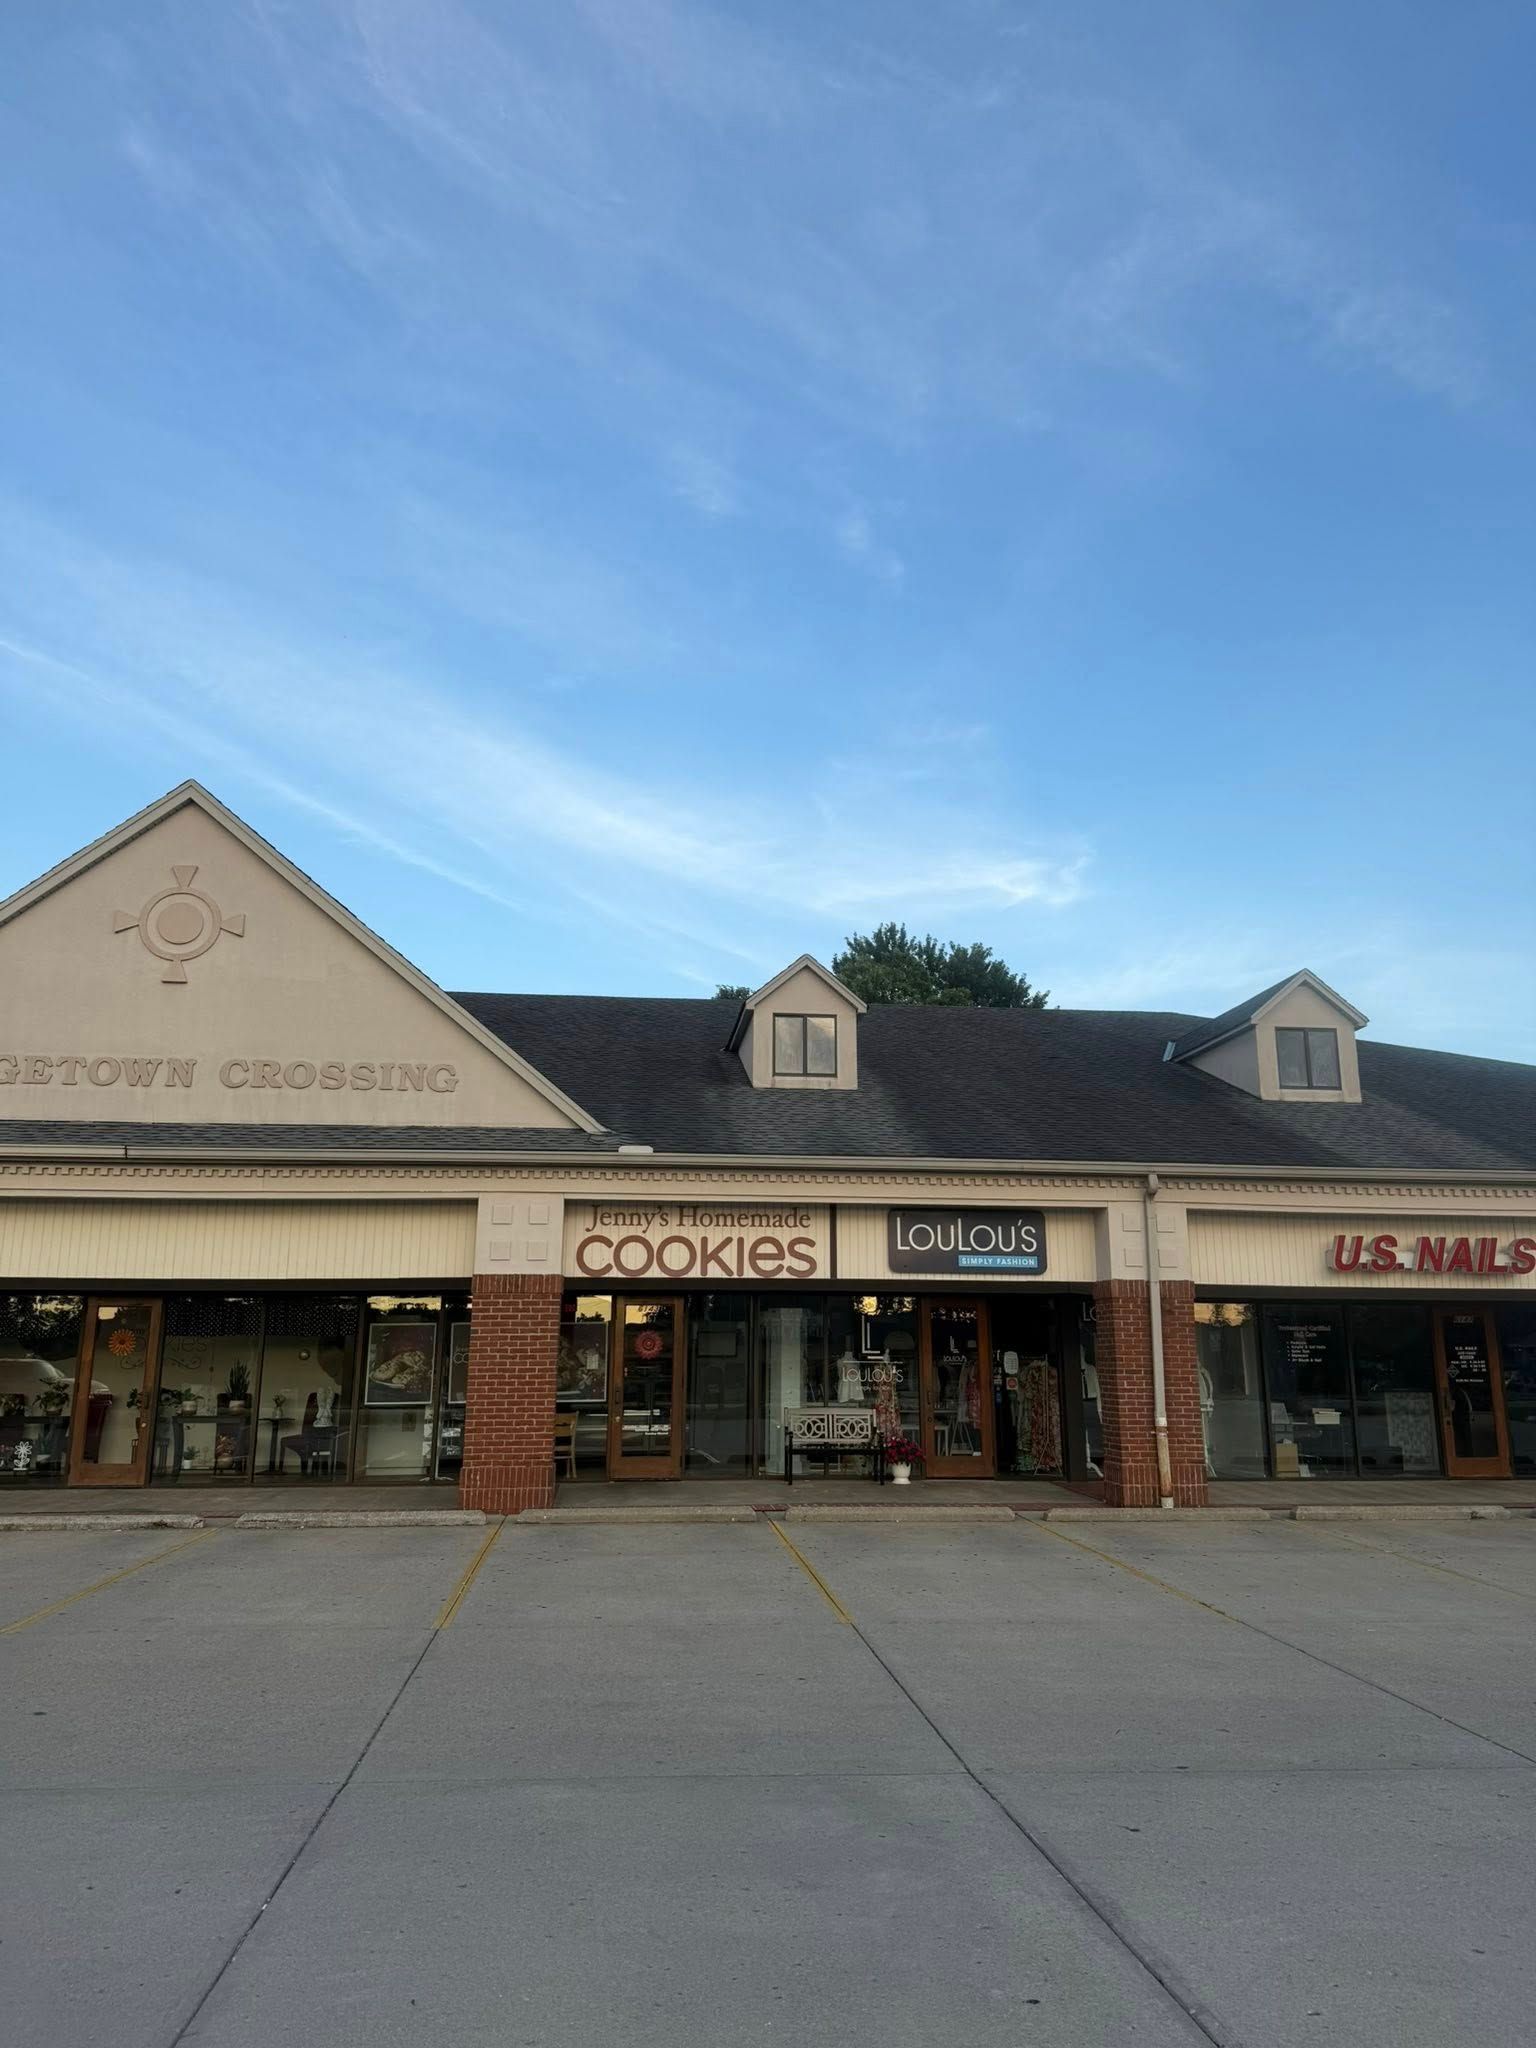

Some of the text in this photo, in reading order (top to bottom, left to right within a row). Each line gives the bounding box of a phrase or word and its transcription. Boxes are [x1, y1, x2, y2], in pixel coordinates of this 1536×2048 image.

[219, 1058, 459, 1093] CROSSING
[586, 1204, 811, 1233] Jenny's Homemade
[961, 1257, 1036, 1268] SIMPLY FASHION
[1333, 1234, 1536, 1275] U.S. NAILS
